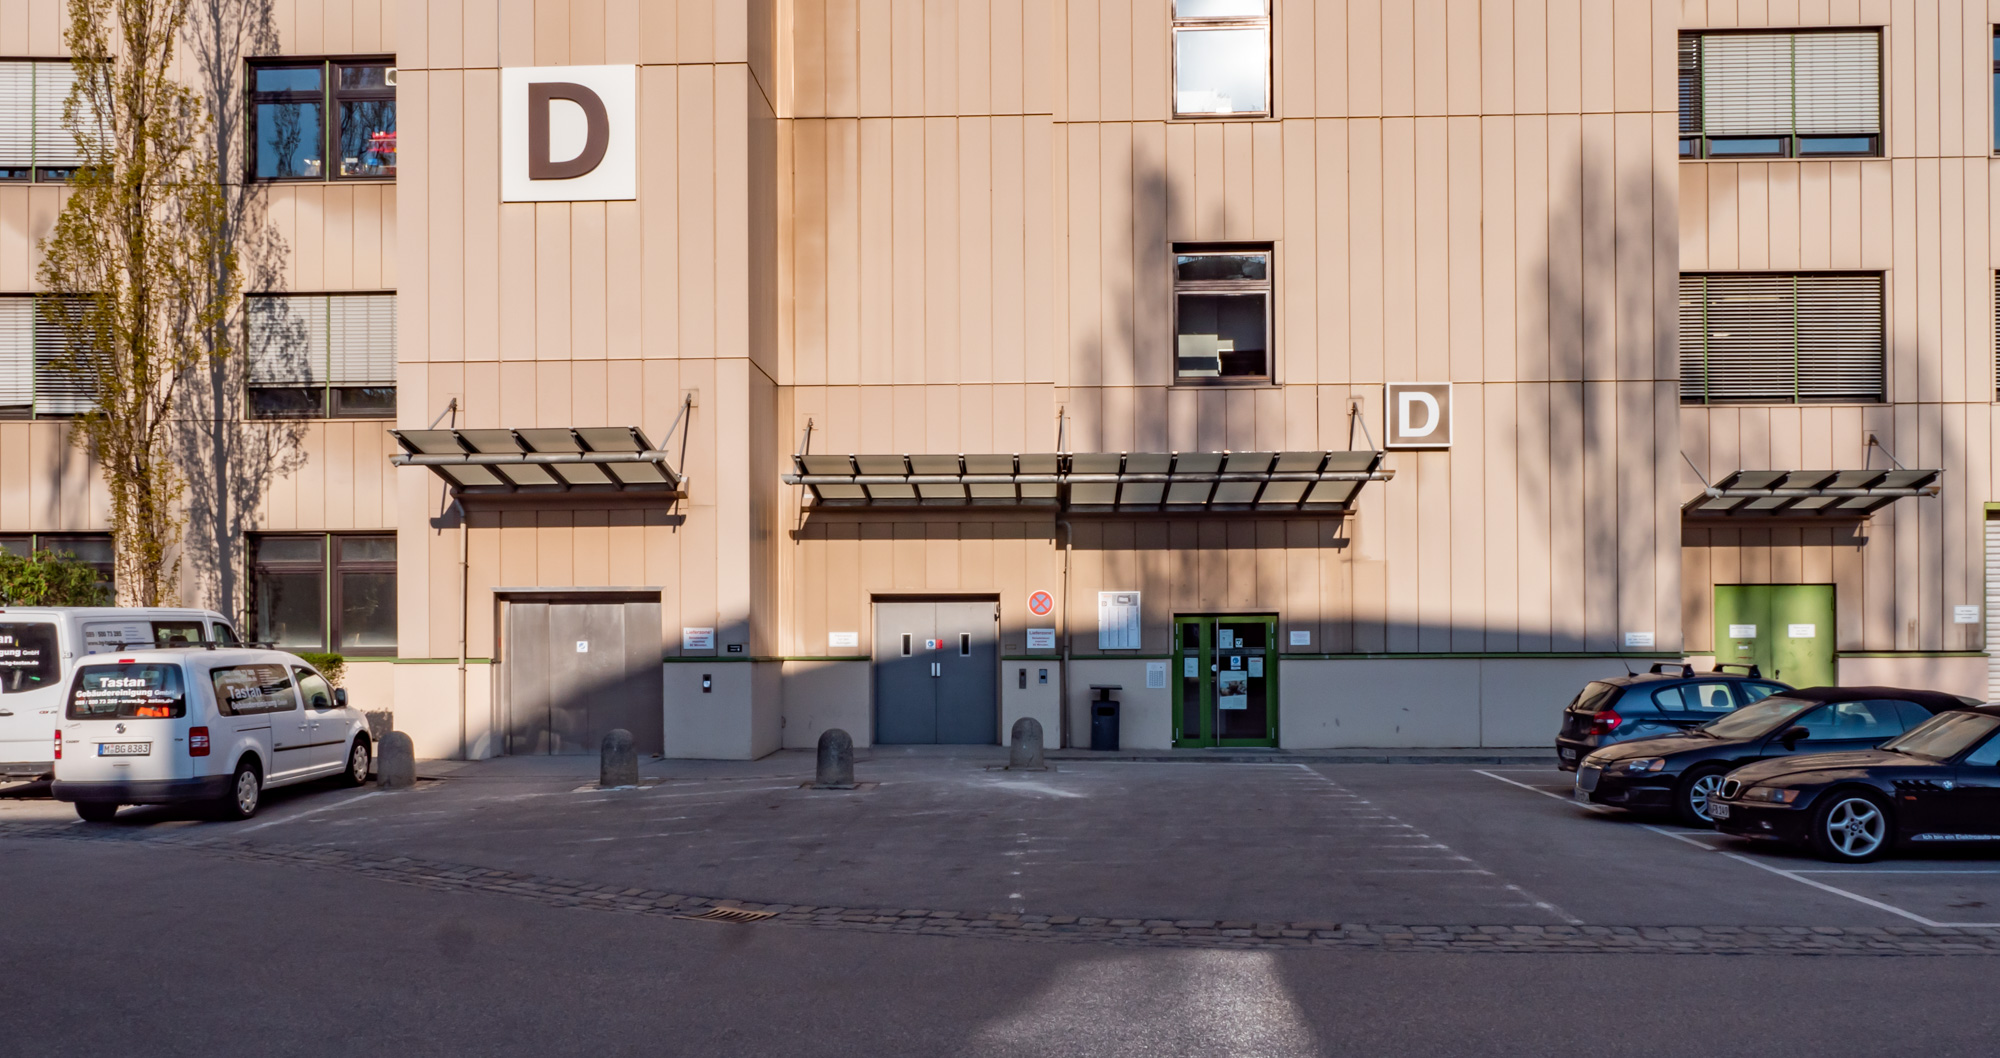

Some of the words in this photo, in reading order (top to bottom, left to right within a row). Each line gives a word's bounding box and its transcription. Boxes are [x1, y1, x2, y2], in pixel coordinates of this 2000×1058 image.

[528, 82, 610, 181] D
[1398, 391, 1440, 437] D
[99, 677, 146, 688] Tastan
[75, 688, 153, 698] Gebäudereinigung
[227, 685, 263, 700] Tastan
[104, 745, 110, 753] M
[115, 744, 126, 753] BG
[127, 744, 149, 753] 8383
